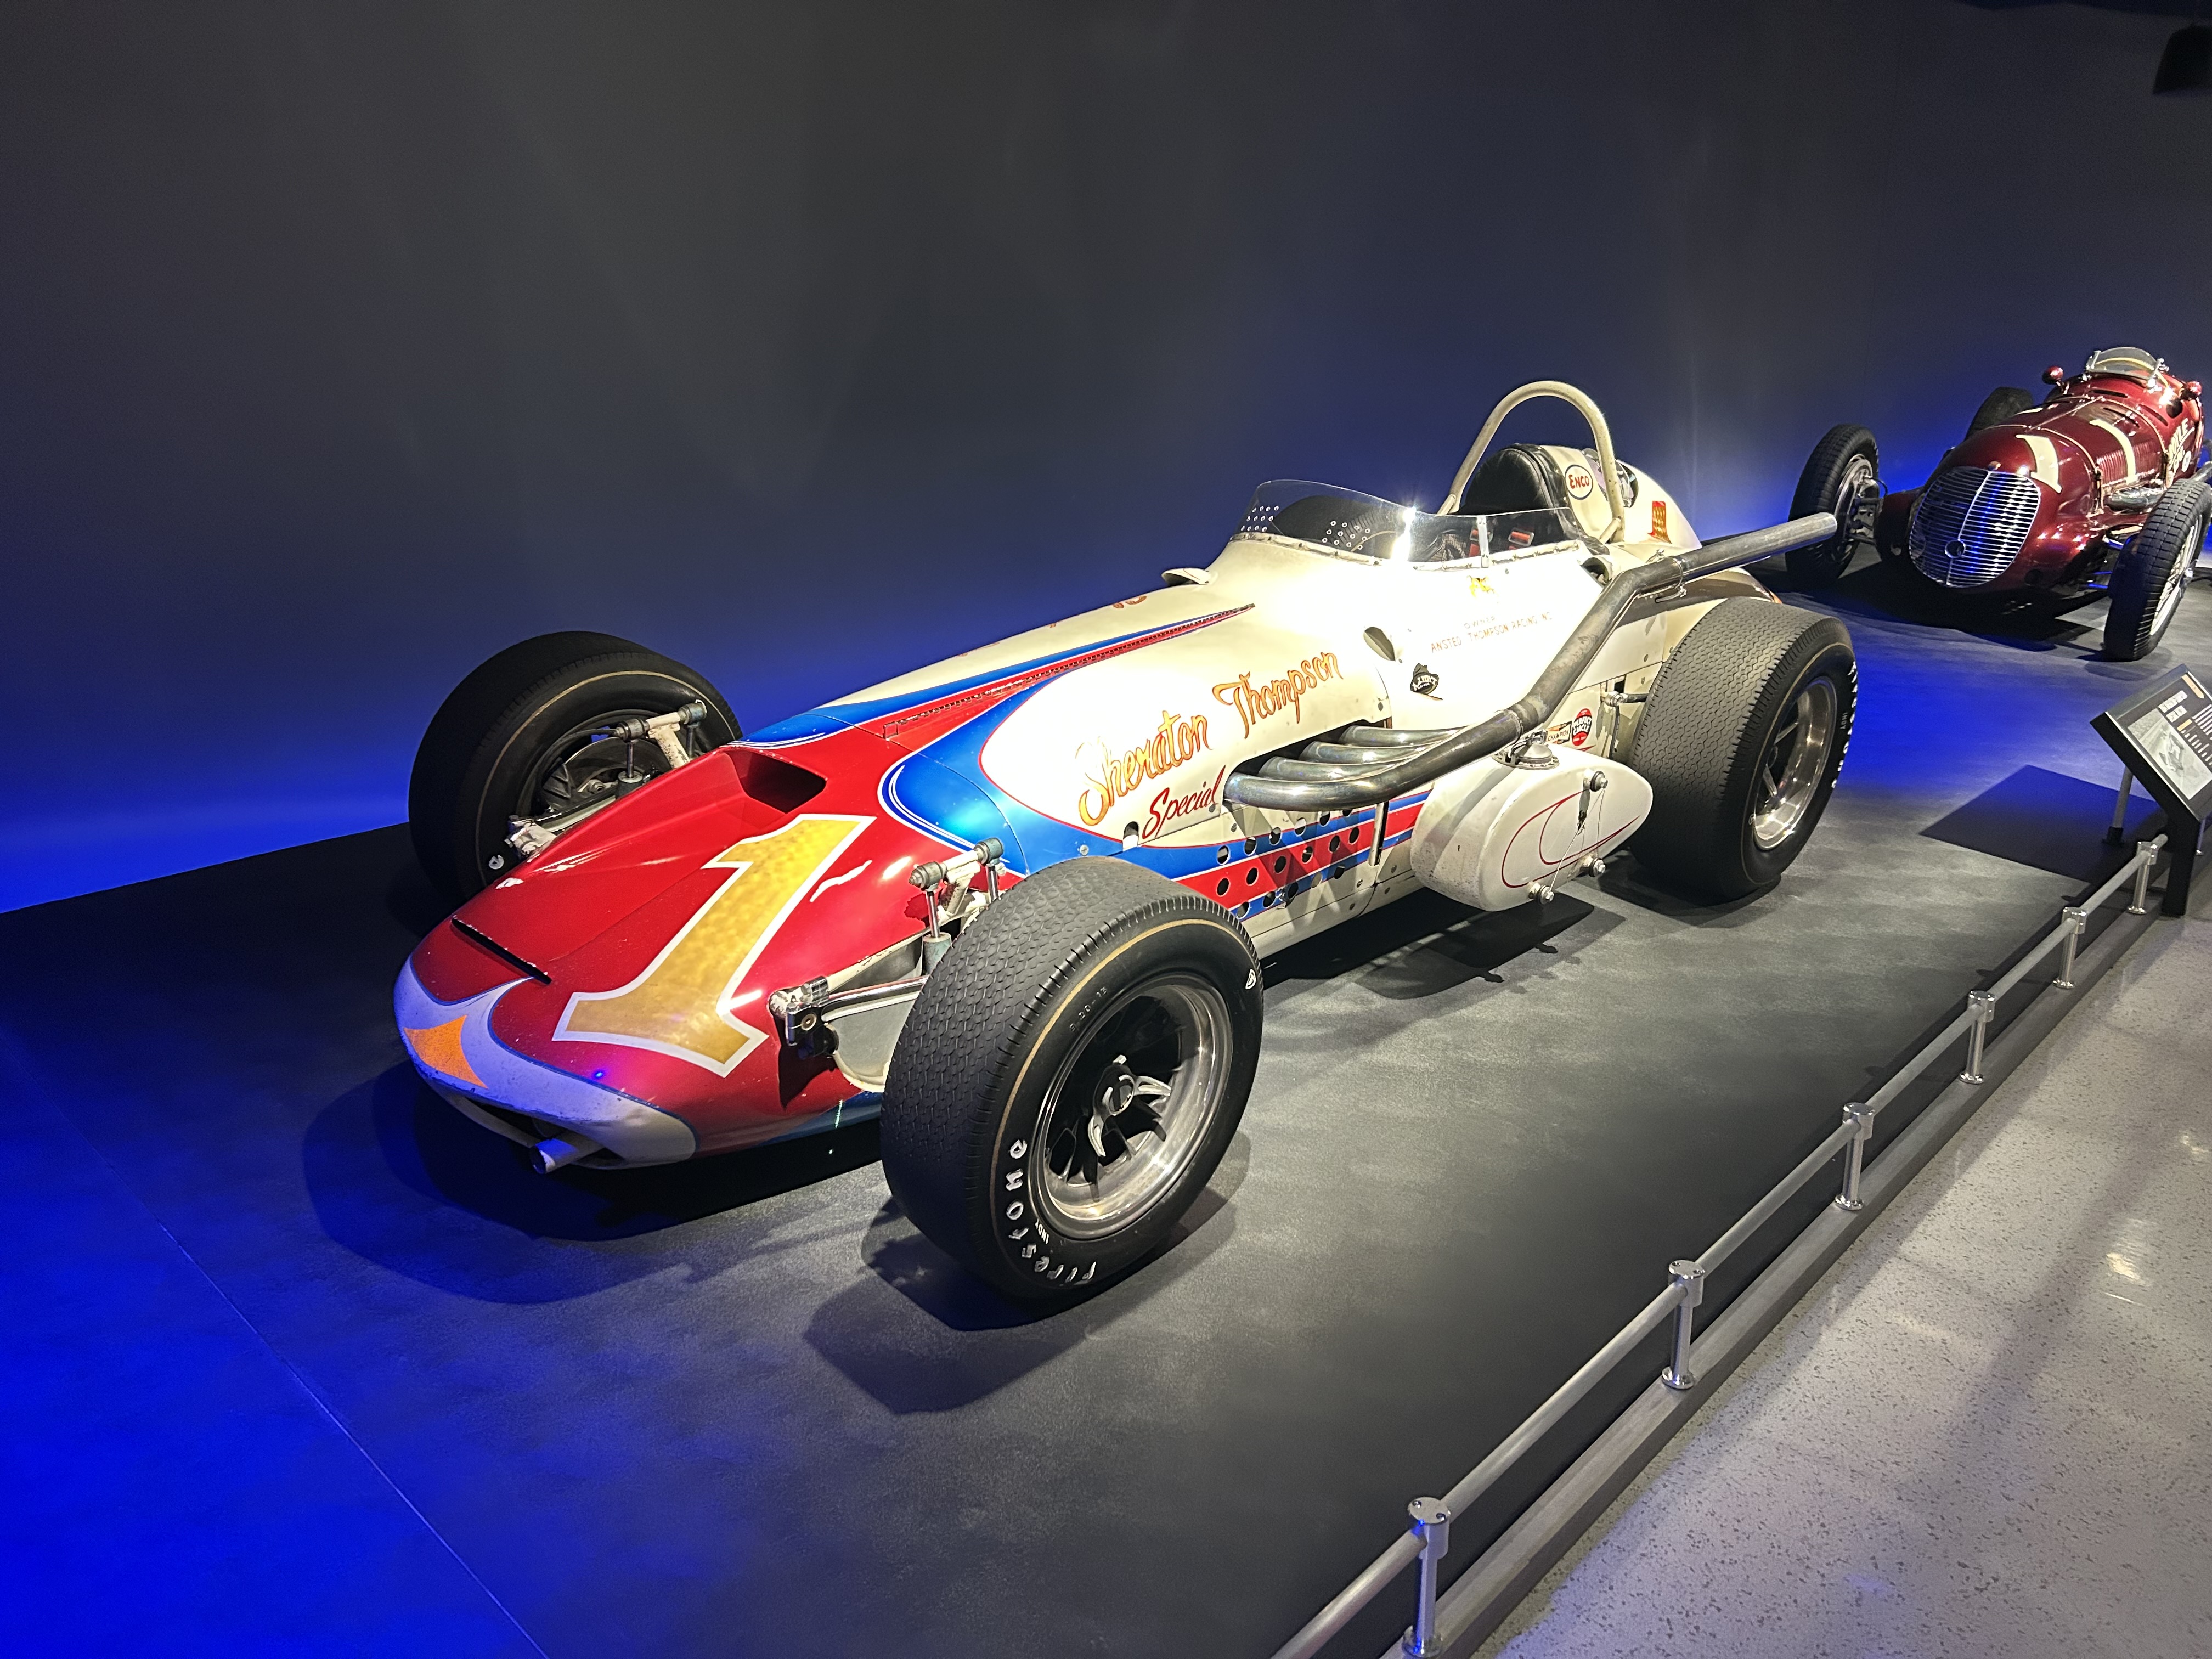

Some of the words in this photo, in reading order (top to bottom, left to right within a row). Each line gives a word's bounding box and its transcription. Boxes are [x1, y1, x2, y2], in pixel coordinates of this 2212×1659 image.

[1568, 474, 1590, 489] ENCO
[2016, 435, 2062, 493] 1
[1431, 636, 1462, 653] ANSTED
[1467, 624, 1509, 641] THOMPSON
[1511, 616, 1538, 630] RACING
[1212, 652, 1344, 739] Thompson
[1548, 730, 1569, 742] CHAMPION
[1075, 710, 1214, 826] Sheraton
[1142, 765, 1226, 839] Special
[551, 814, 877, 1078] 1
[1035, 1218, 1050, 1244] INDY
